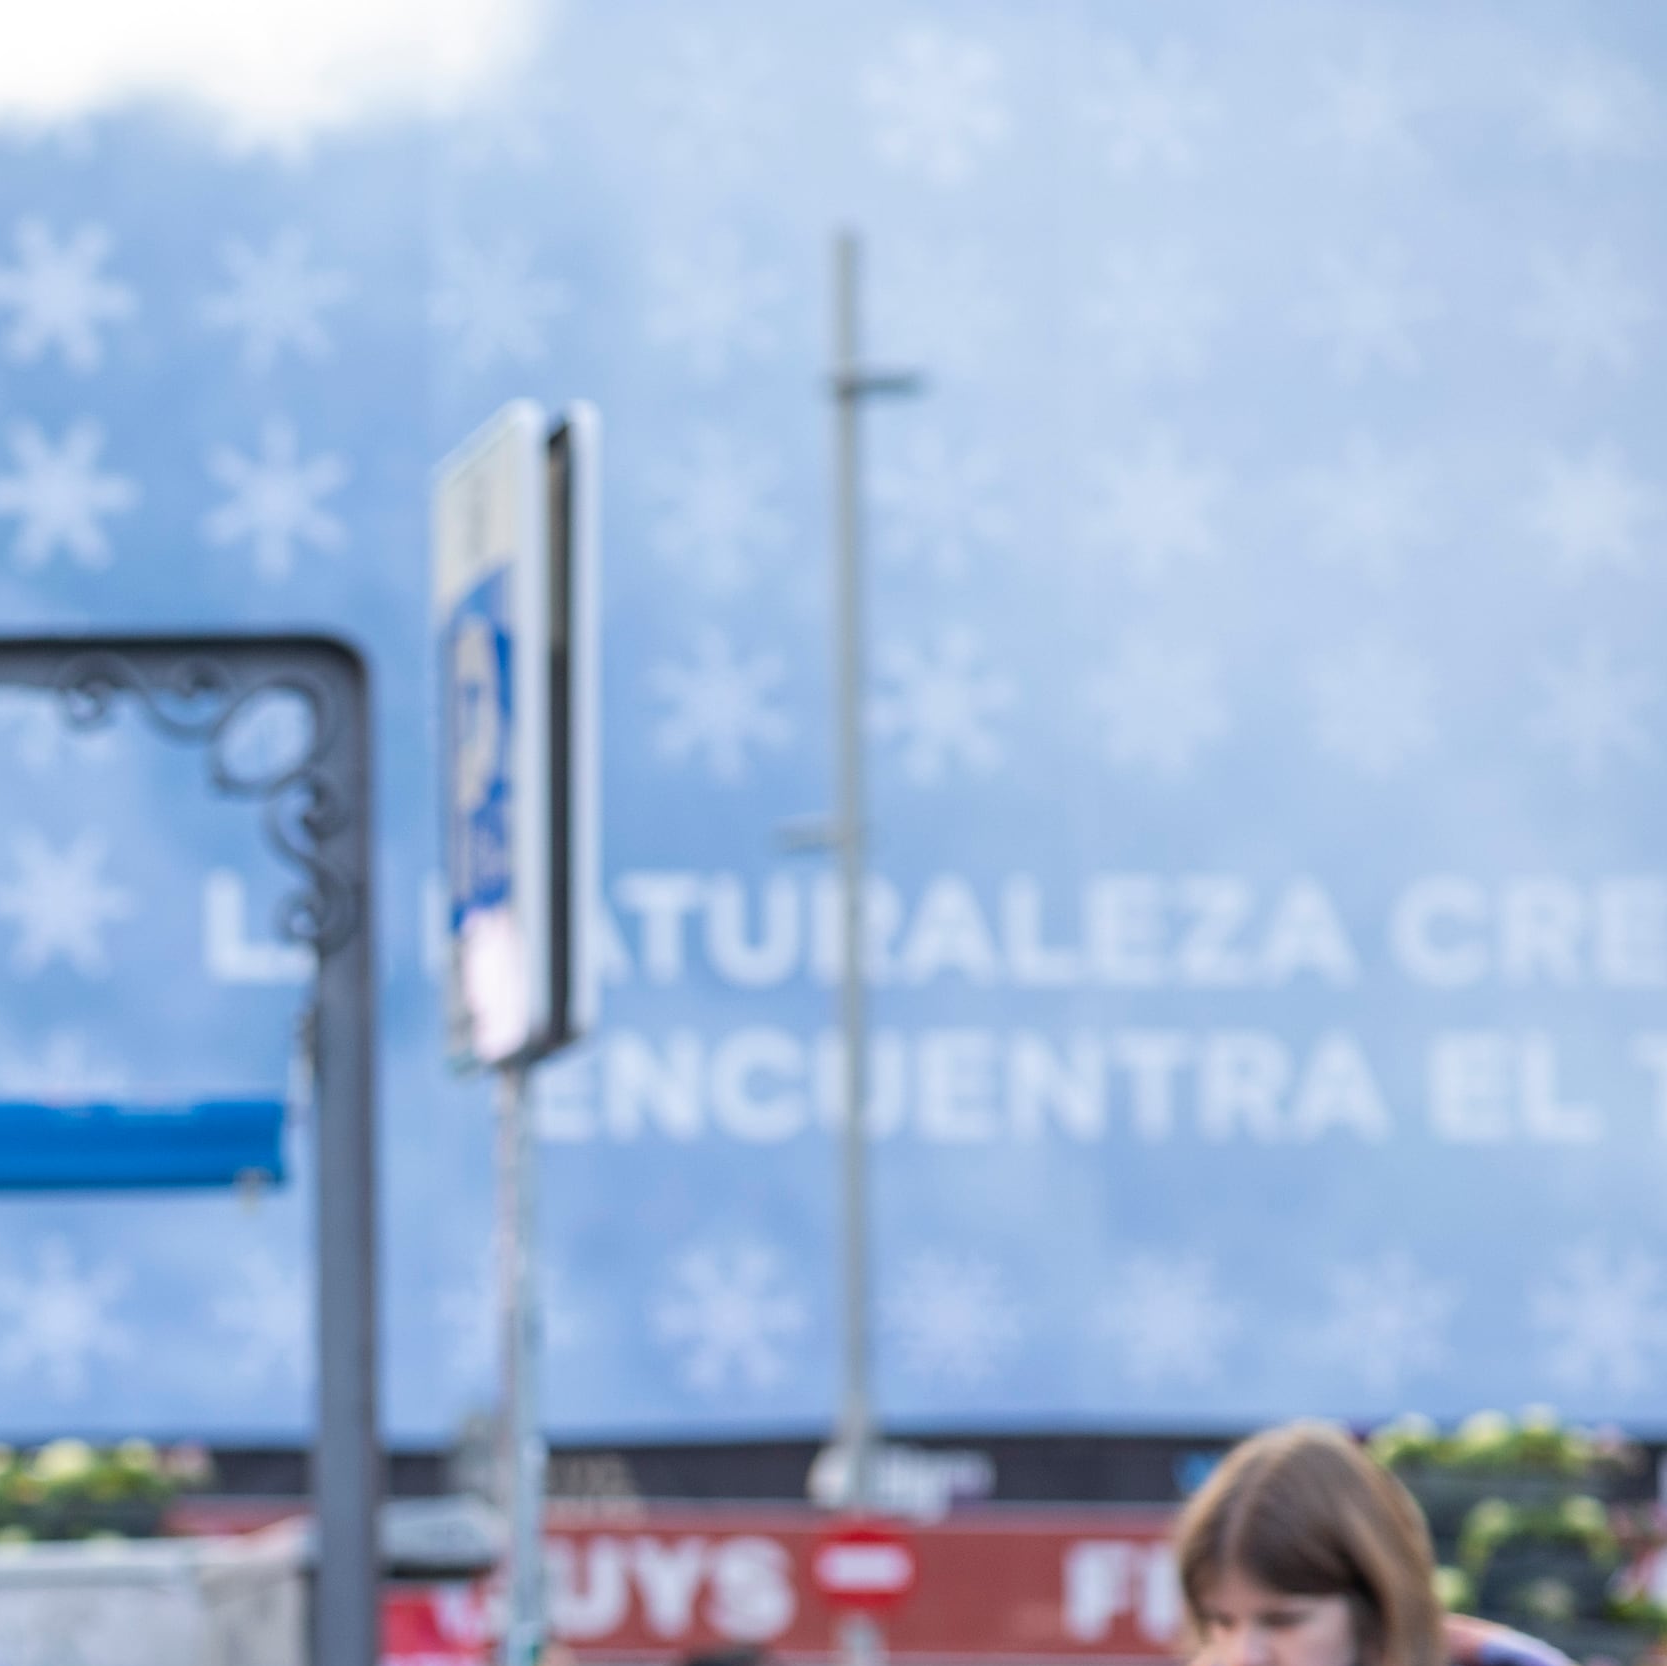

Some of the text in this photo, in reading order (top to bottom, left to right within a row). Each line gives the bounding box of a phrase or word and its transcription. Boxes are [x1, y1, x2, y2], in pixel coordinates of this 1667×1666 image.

[204, 871, 319, 985] L
[533, 1024, 1393, 1145] ENCUENTRA
[1429, 1027, 1603, 1144] EL
[482, 1534, 795, 1641] UYS
